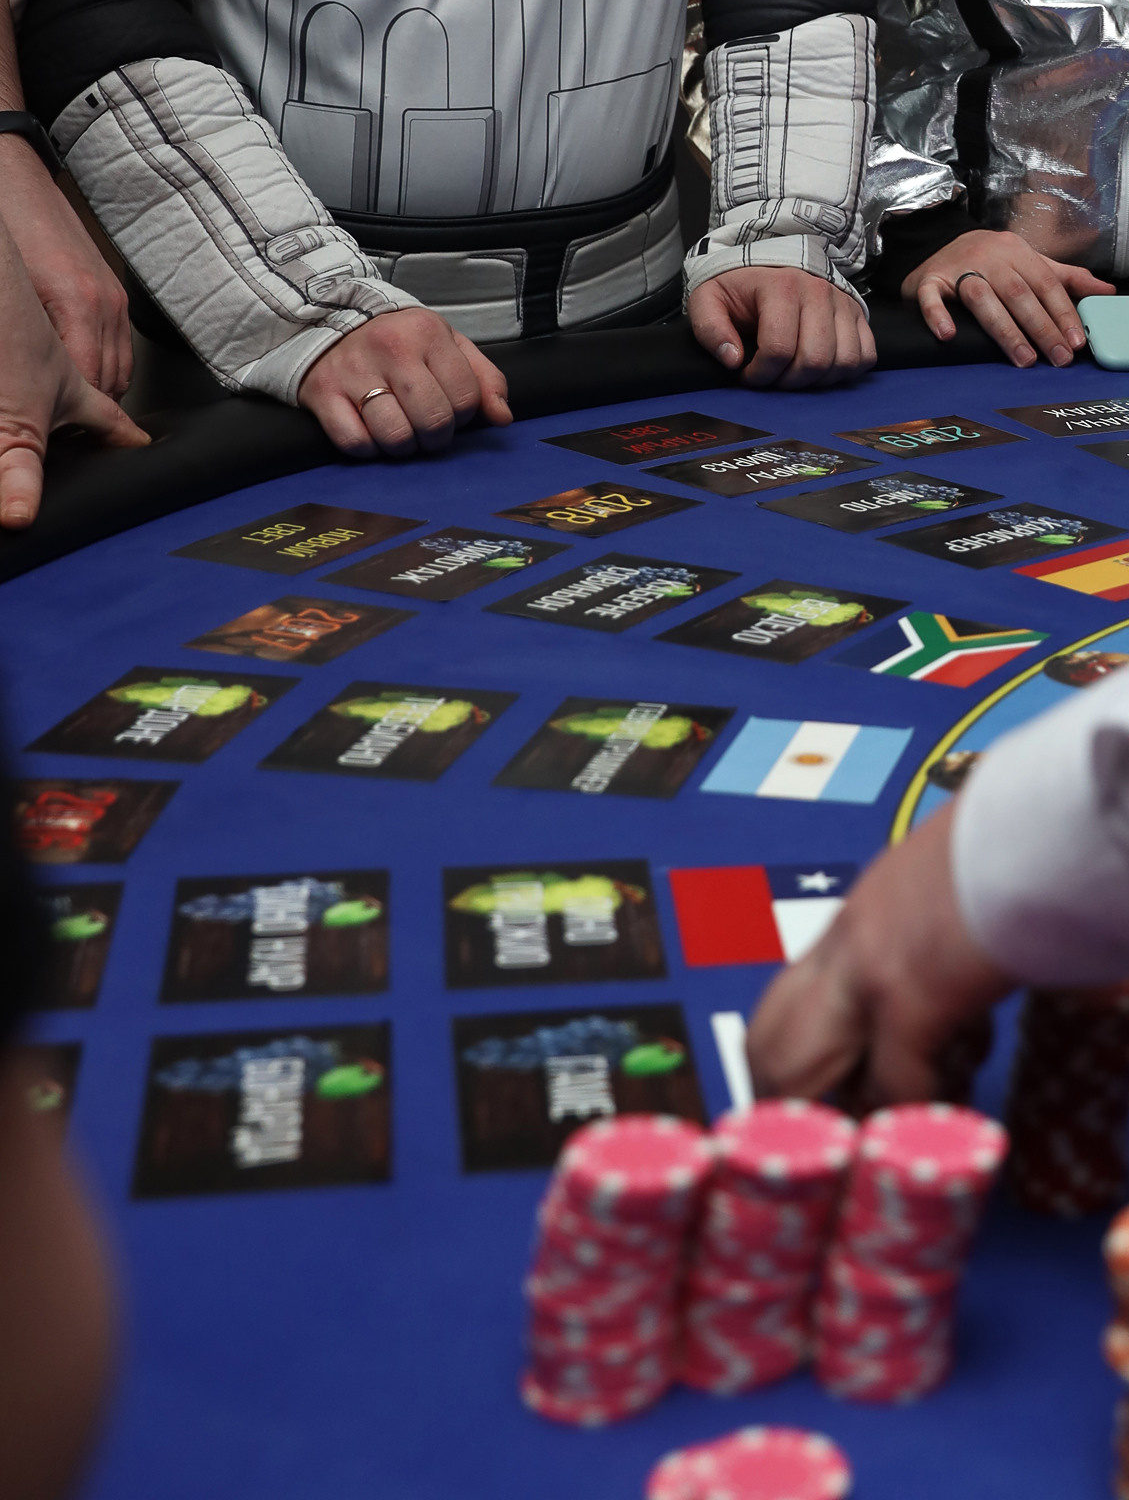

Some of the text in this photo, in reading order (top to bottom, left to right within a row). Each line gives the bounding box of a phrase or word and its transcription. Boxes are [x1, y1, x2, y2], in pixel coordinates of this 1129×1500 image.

[610, 425, 670, 440] СВЕТ
[623, 432, 718, 455] СТАРЫЙ
[879, 425, 981, 448] 2019
[701, 451, 786, 473] ШИРАЗ
[545, 493, 652, 525] 2018
[840, 490, 924, 512] МЕРЛО
[241, 523, 306, 544] СВЕТ
[277, 528, 364, 558] НОВЫЙ
[945, 517, 1063, 553] КАРМЕНЕР
[390, 540, 503, 585] ПИНОТАЖ
[526, 566, 640, 612] СОВИНЬОН
[585, 578, 688, 620] КАБЕРНЕ
[251, 608, 360, 650] 2017
[732, 598, 841, 646] ВЕРДЕХО
